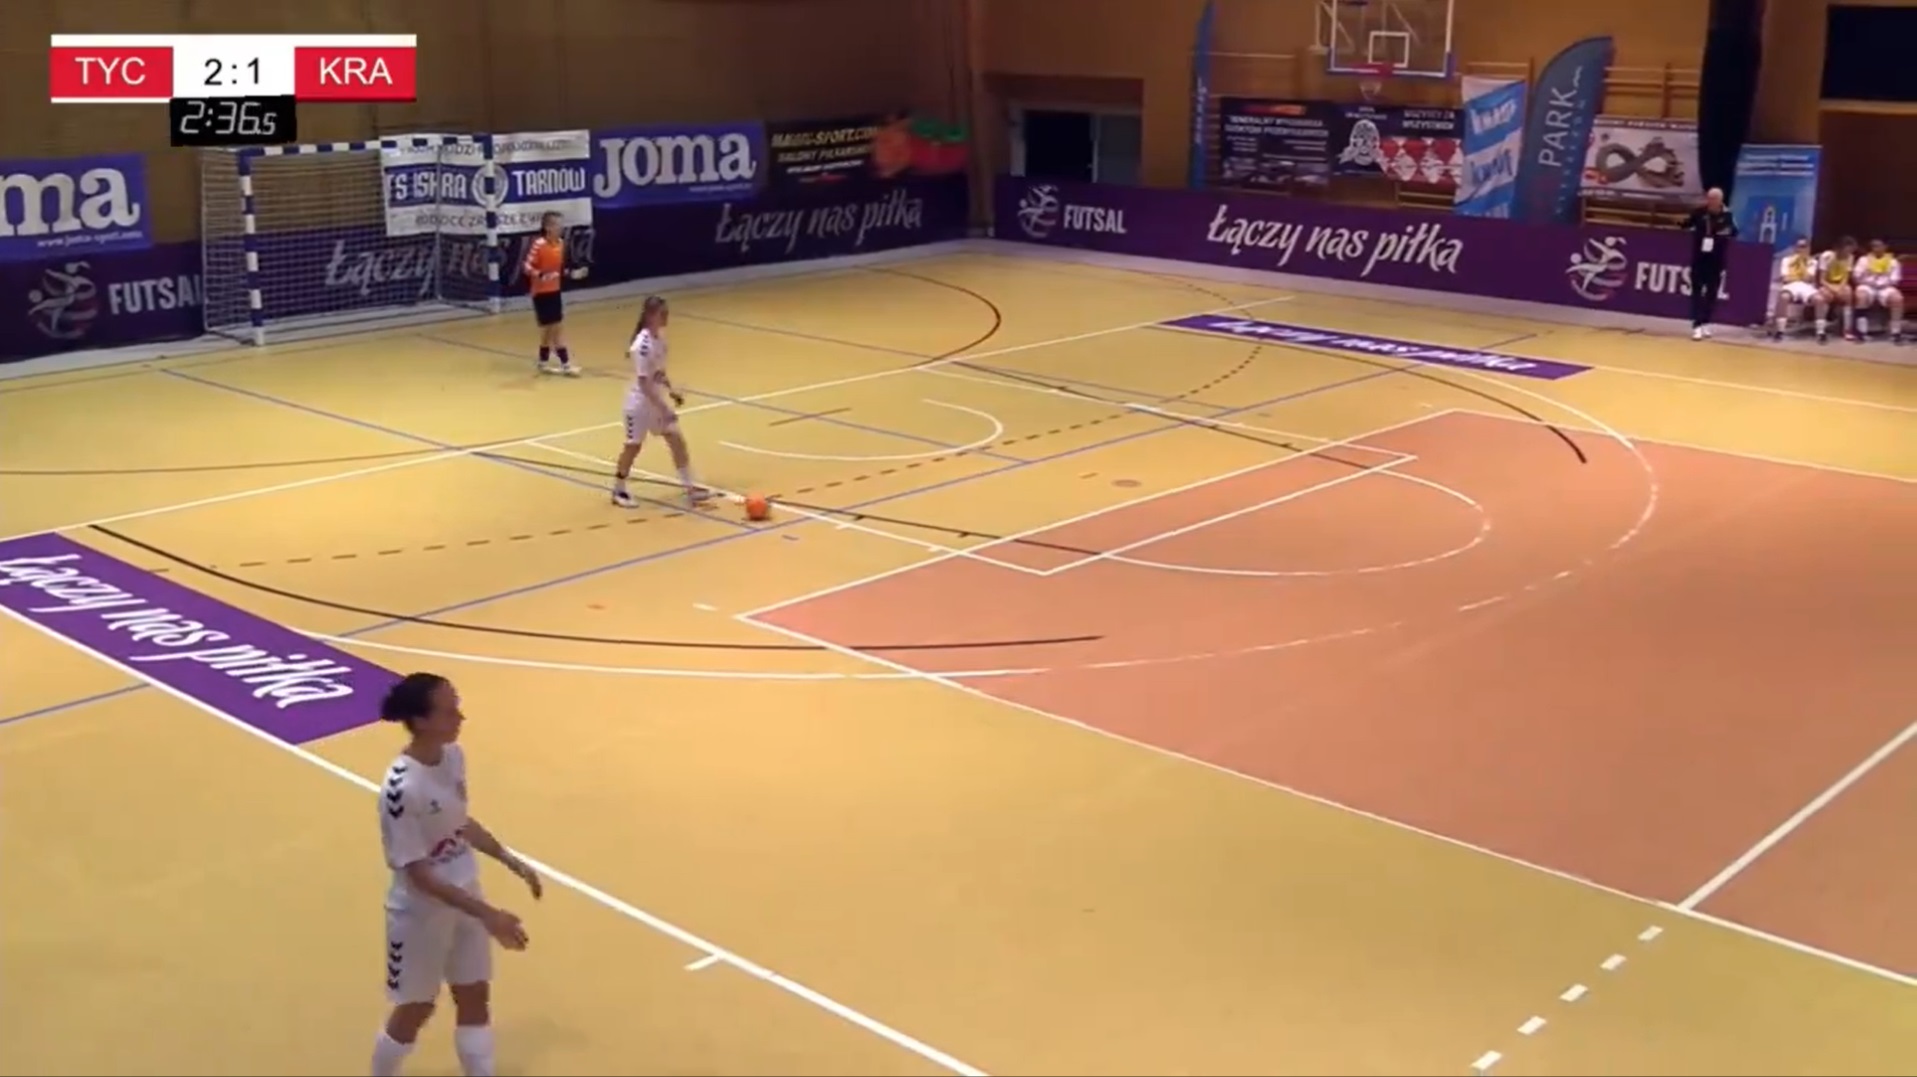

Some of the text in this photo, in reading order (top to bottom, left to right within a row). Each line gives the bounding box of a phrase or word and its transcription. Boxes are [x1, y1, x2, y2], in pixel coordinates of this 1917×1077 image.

[1538, 87, 1578, 168] PARK
[512, 166, 586, 196] TARNÓW
[715, 188, 924, 254] Łączy nas piłka
[1063, 204, 1127, 235] FUTSAL
[1207, 204, 1464, 278] Łączy nas piłka
[1635, 261, 1730, 300] FUTSL
[0, 554, 354, 709] Łączy nas piłka
